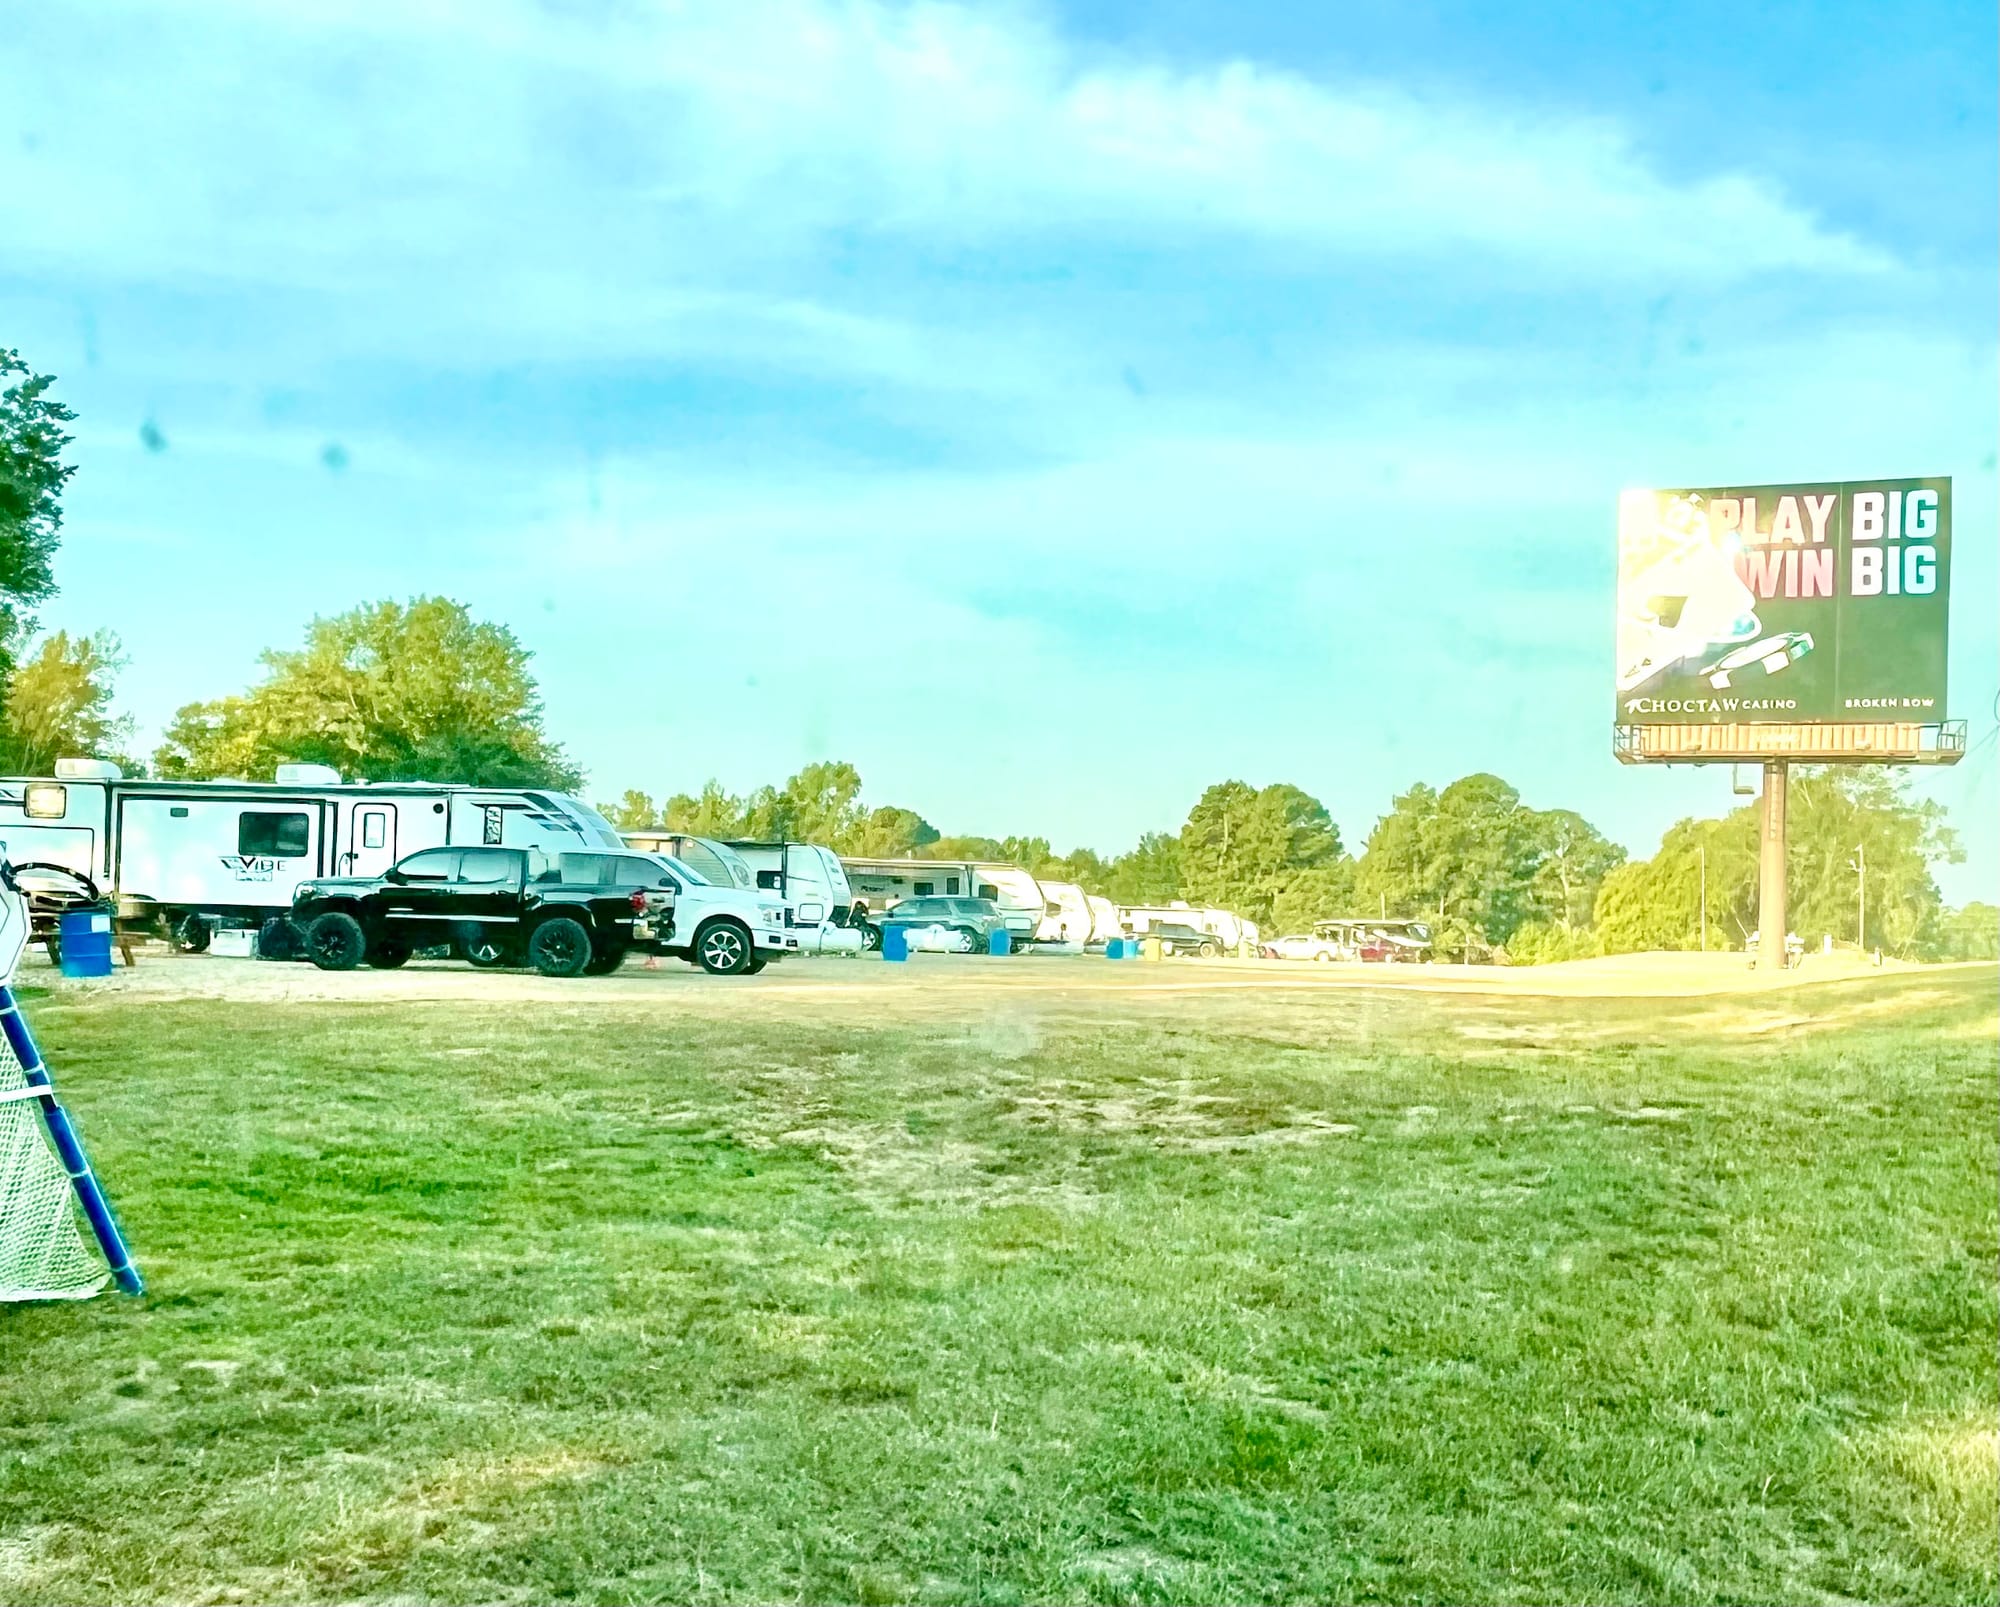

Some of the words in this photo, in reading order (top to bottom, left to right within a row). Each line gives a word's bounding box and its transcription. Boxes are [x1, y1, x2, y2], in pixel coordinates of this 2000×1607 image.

[1710, 495, 1836, 545] PLAY
[1852, 489, 1938, 540] BIG
[1734, 548, 1833, 598] WIN
[1851, 545, 1937, 596] BIG
[1638, 697, 1740, 714] CHOCTAW
[1742, 699, 1797, 710] CASINO
[1845, 698, 1898, 708] BROKEN
[1902, 698, 1935, 707] BOW
